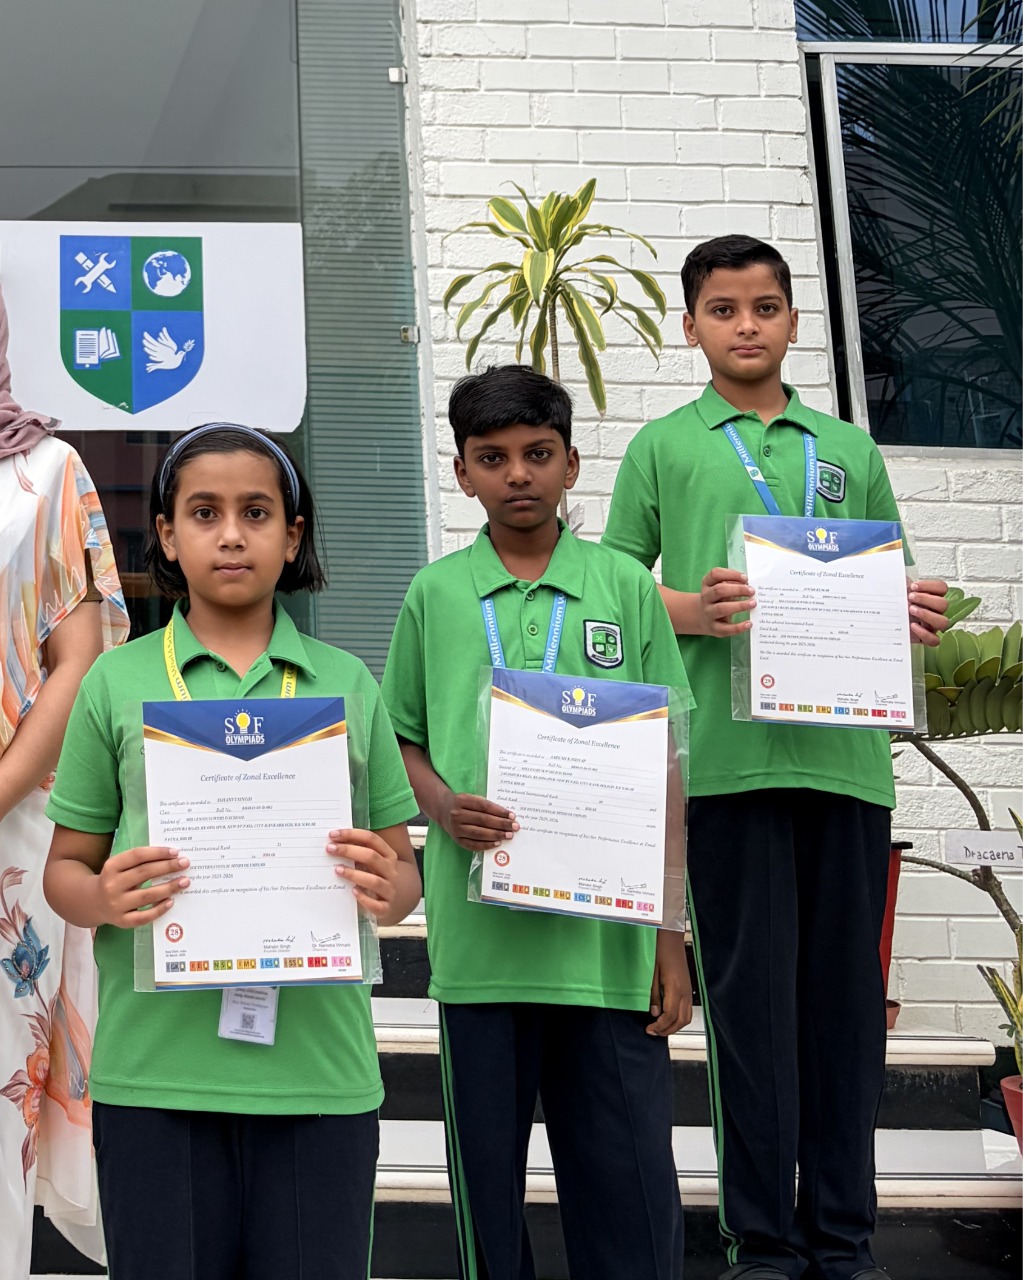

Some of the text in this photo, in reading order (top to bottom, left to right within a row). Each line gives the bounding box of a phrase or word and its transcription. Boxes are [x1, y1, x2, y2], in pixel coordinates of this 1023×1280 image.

[725, 423, 751, 464] Millenniu
[806, 458, 815, 517] Millennium
[484, 600, 502, 667] Millennium
[545, 611, 563, 671] Millennium
[225, 734, 264, 744] OLYMPIADS
[200, 773, 234, 783] Certificate
[234, 773, 242, 781] of
[262, 772, 295, 780] Excellence
[964, 846, 1015, 861] Dracaena
[169, 927, 178, 935] 28
